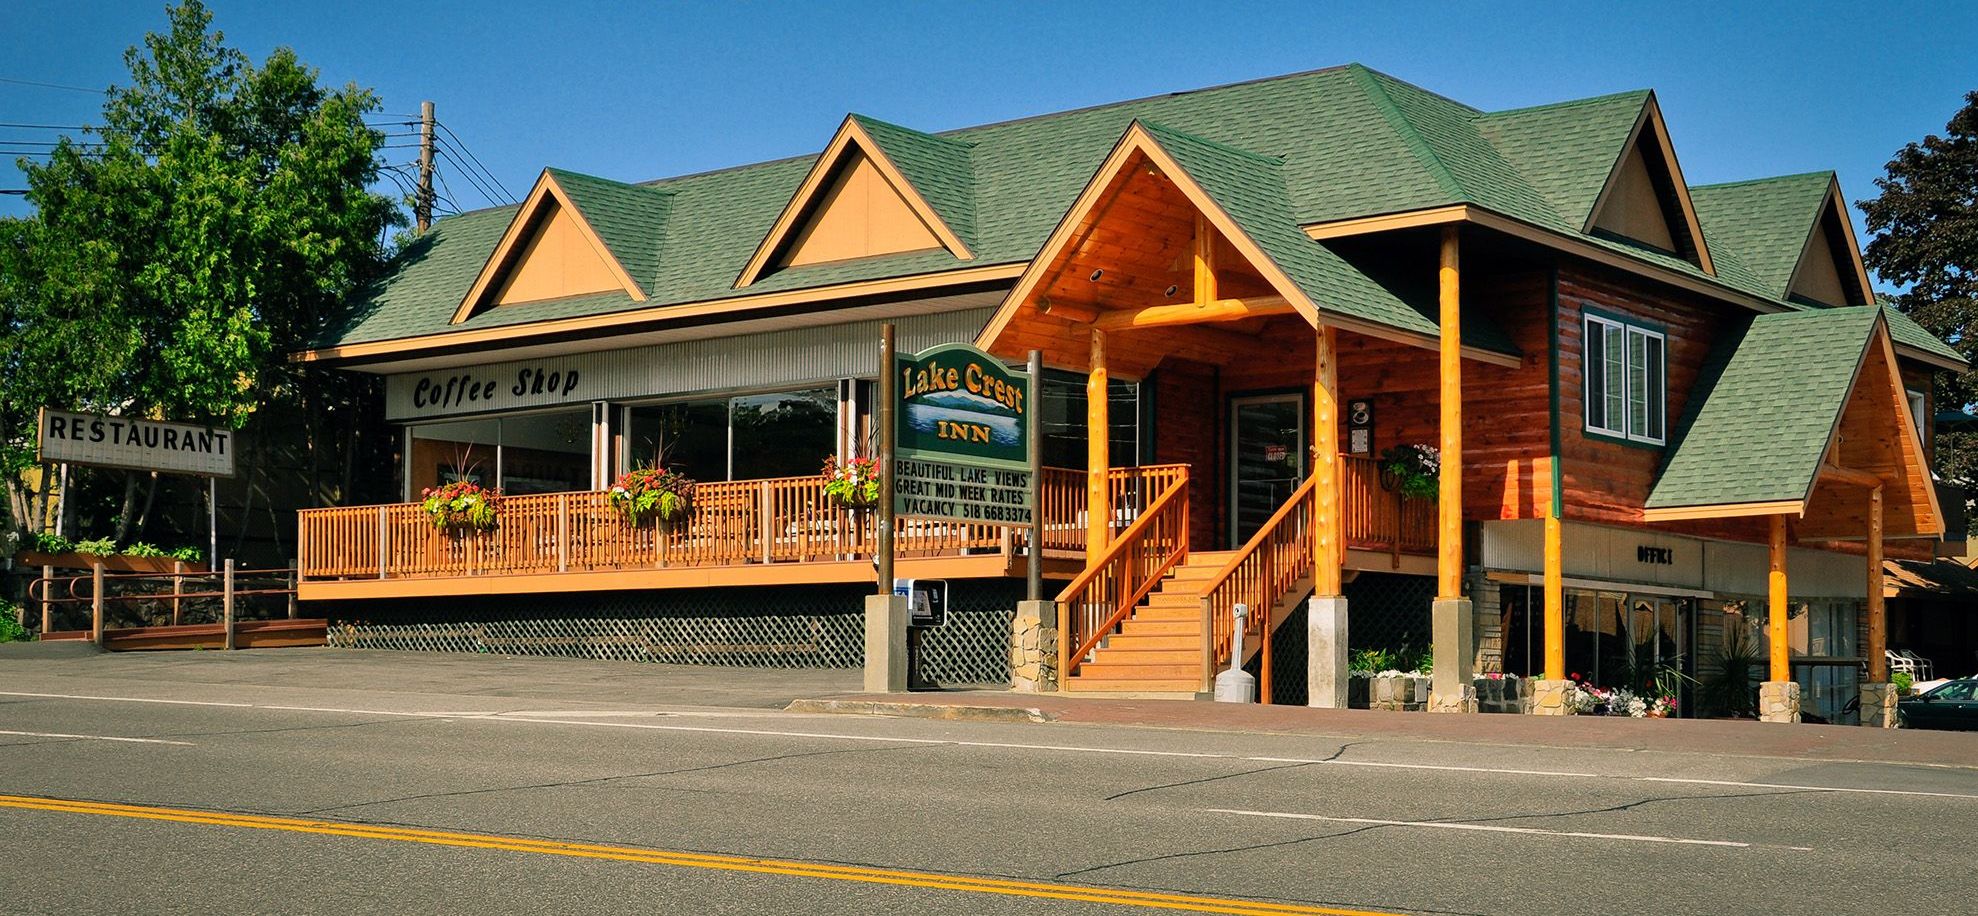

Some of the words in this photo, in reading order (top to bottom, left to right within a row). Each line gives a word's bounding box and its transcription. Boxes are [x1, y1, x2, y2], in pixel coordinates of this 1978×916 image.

[414, 375, 496, 408] Coffee
[512, 368, 579, 396] Shop
[903, 361, 959, 400] Lake
[964, 363, 1023, 414] Crest
[50, 416, 227, 454] RESTAURANT
[937, 421, 991, 443] INN
[897, 460, 954, 481] BEAUTIFUL
[961, 467, 987, 483] LAKE
[995, 471, 1027, 488] VIEWS
[896, 479, 931, 496] GREAT
[936, 483, 955, 498] MID
[959, 485, 985, 501] WEEK
[991, 488, 1024, 505] RATES
[904, 498, 955, 516] VACANCY
[963, 503, 980, 518] 518
[1637, 546, 1672, 565] OFFICE
